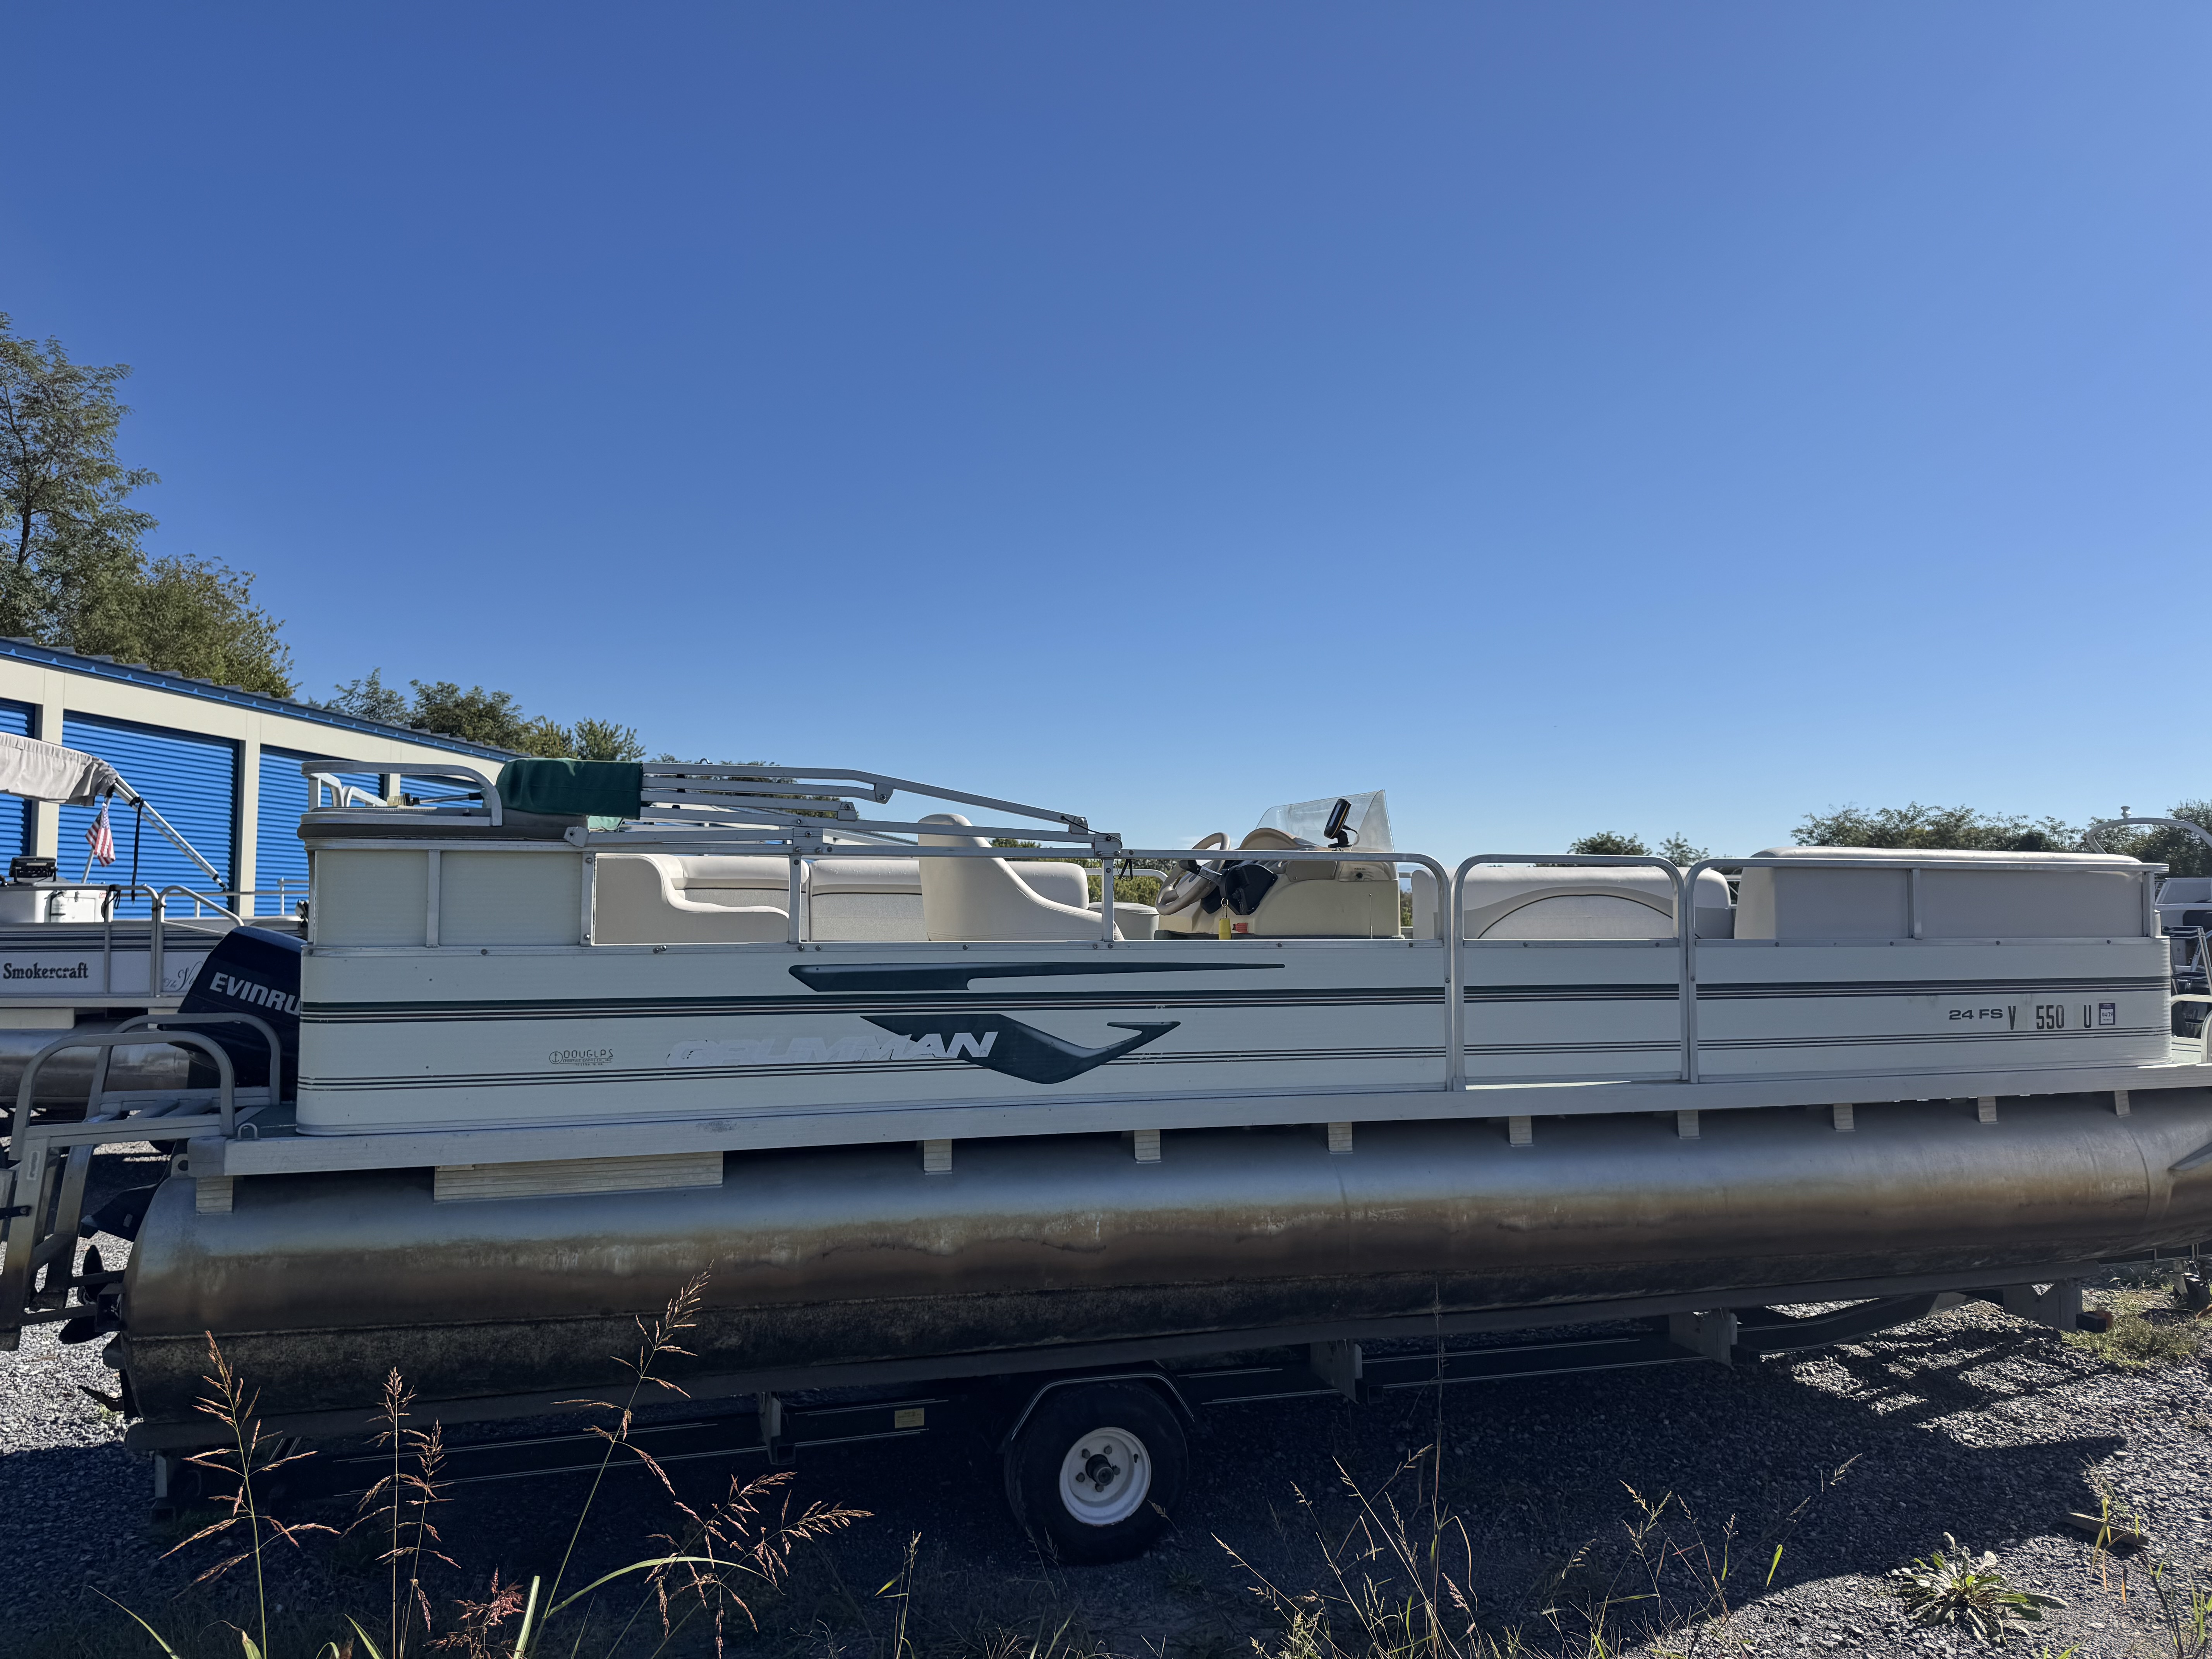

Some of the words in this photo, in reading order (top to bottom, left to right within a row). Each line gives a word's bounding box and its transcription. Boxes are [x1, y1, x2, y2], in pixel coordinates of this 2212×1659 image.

[3, 962, 89, 979] Smokercraft
[1949, 1010, 1974, 1020] 24
[1979, 1009, 2003, 1019] FS
[2008, 1006, 2016, 1030] V
[2036, 1005, 2064, 1030] 550
[2084, 1005, 2092, 1028] U
